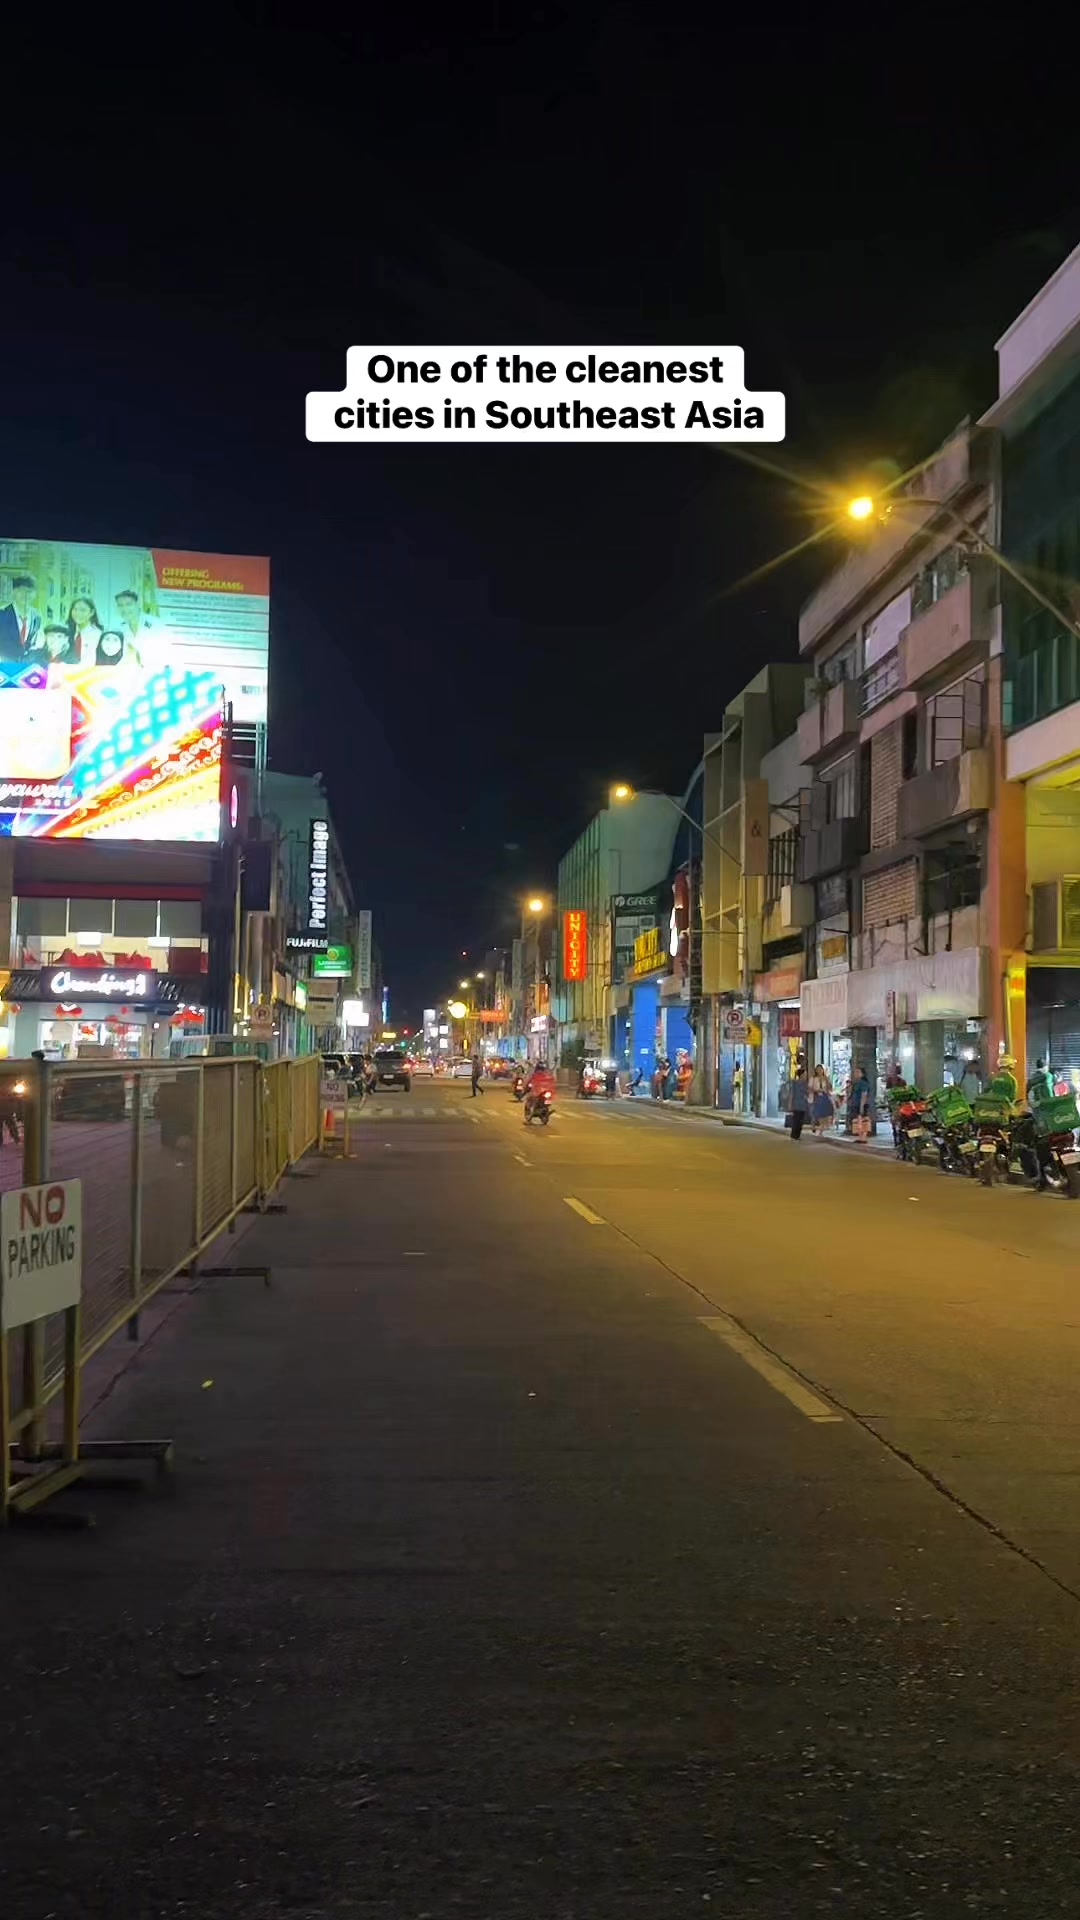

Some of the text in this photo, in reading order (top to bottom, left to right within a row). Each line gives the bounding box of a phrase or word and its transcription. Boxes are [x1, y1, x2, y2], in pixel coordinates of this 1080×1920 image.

[161, 567, 209, 579] OFFERING
[161, 577, 186, 586] NEW
[309, 821, 329, 928] Perfect Image
[626, 895, 657, 906] GREE
[286, 937, 328, 948] FUJIFILM
[569, 912, 581, 977] UNICITY
[20, 1186, 65, 1230] NO
[8, 1225, 74, 1278] PARKING
